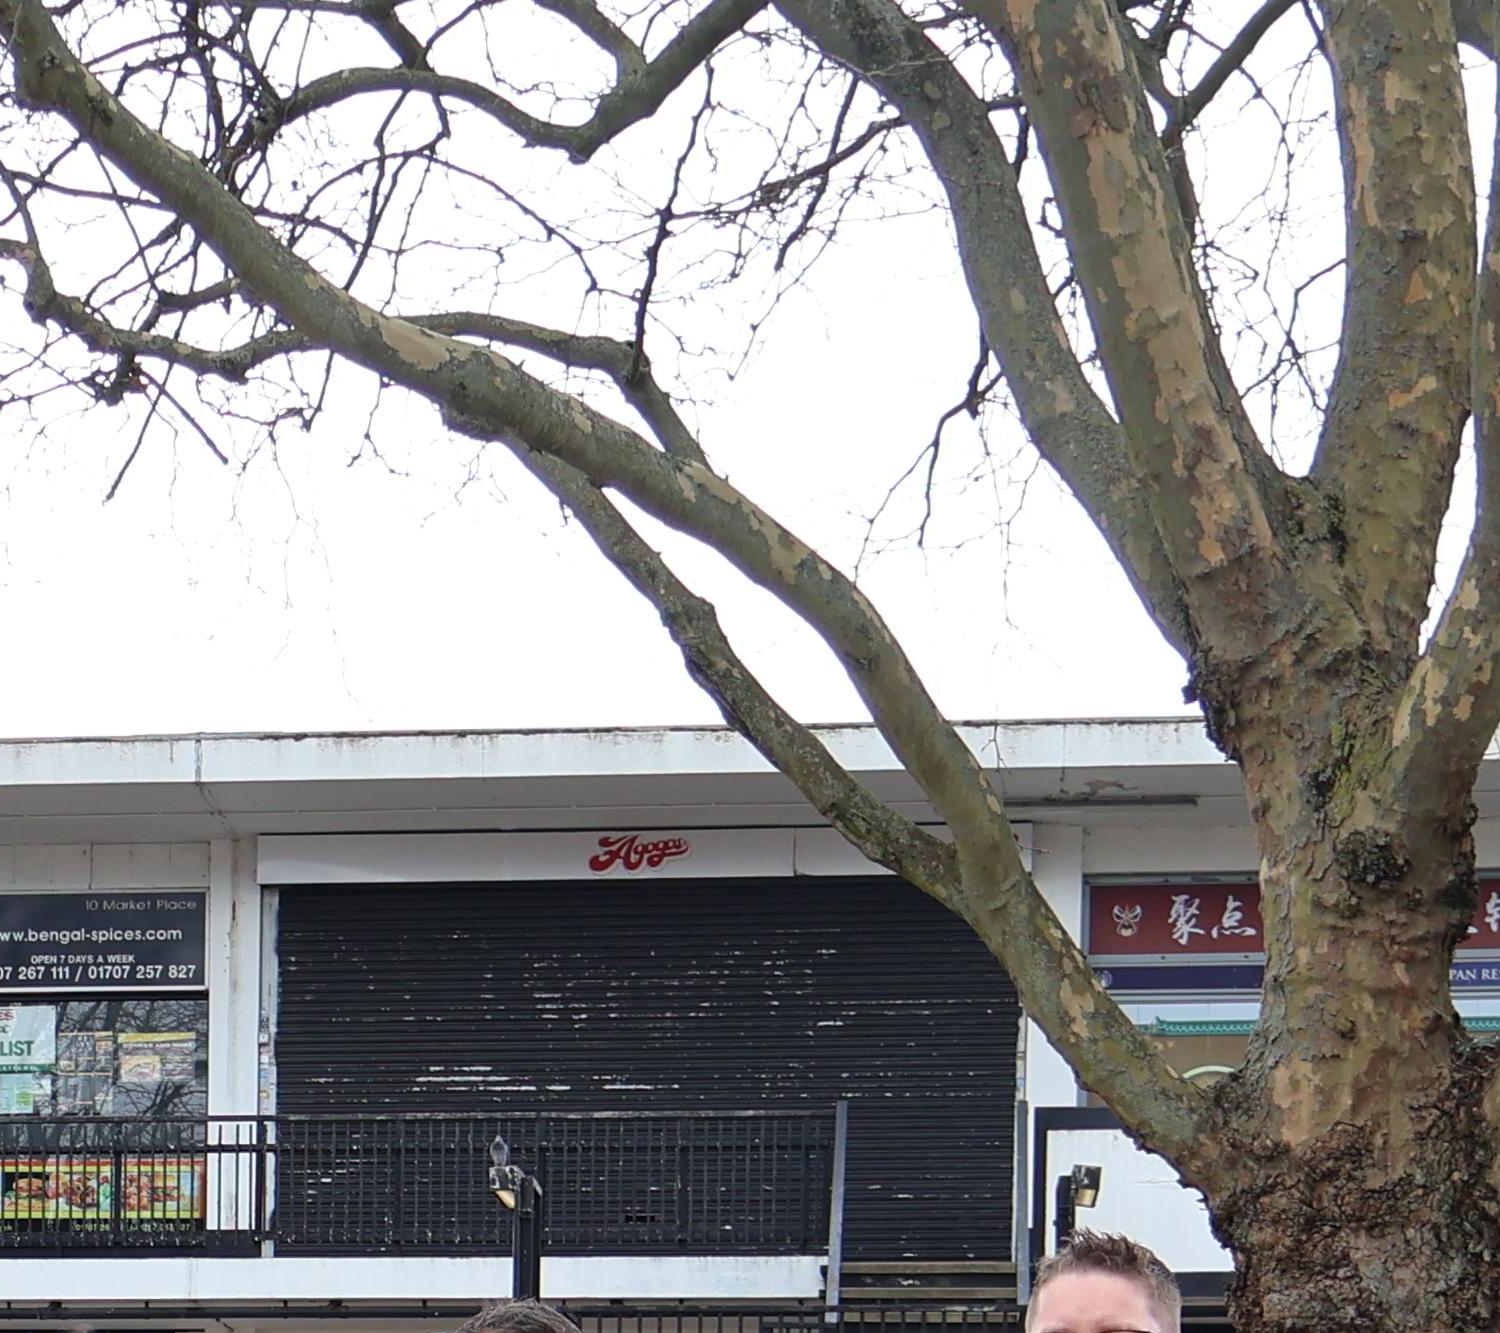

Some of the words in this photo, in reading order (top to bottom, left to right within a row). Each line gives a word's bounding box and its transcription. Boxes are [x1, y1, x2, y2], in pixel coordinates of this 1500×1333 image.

[85, 900, 99, 911] 10
[103, 900, 151, 911] Market
[156, 900, 198, 911] Place
[30, 955, 57, 964] OPEN
[59, 955, 66, 963] 7
[68, 955, 94, 963] DAYS
[96, 955, 104, 963] A
[107, 954, 136, 963] WEEK
[18, 966, 46, 980] 267
[51, 966, 70, 980] 111
[74, 965, 81, 982] /
[87, 965, 131, 980] 01707
[136, 965, 163, 979] 257
[168, 964, 197, 979] 827
[1449, 969, 1476, 981] PAN
